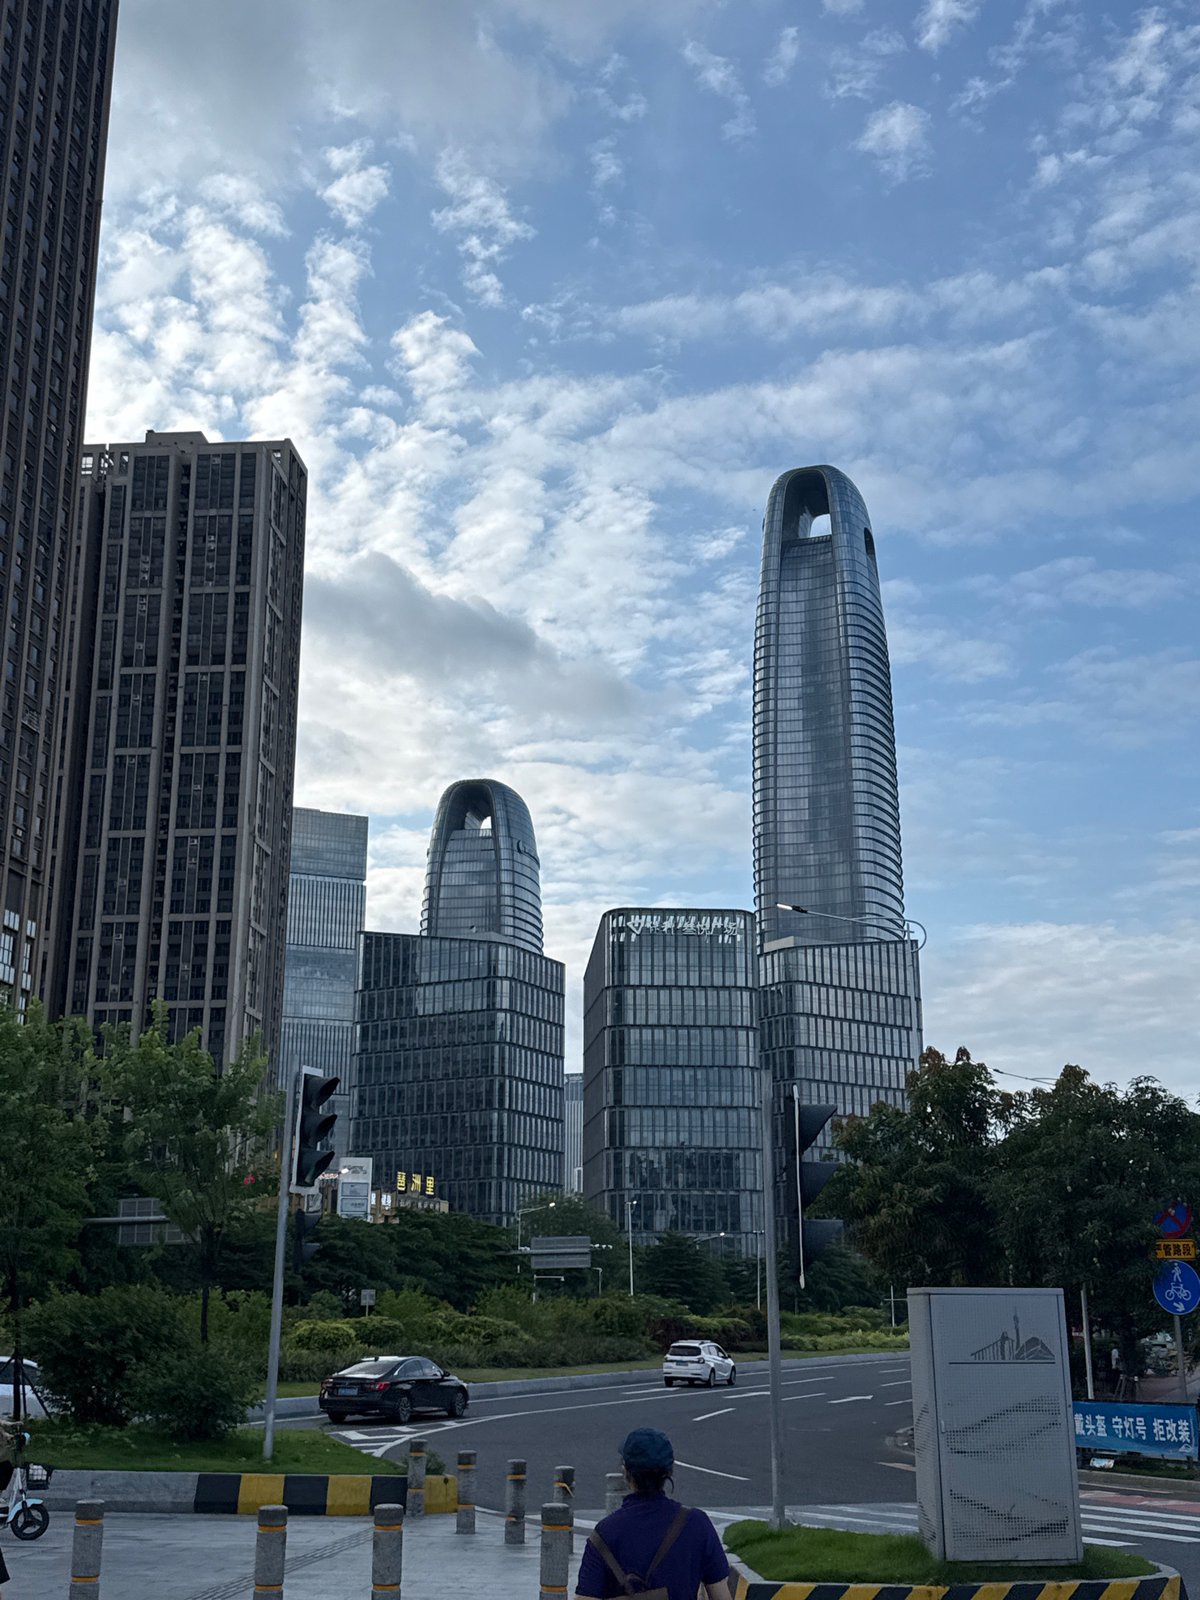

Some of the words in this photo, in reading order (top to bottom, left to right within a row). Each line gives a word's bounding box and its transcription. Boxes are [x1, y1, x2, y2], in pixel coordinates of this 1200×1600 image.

[396, 1171, 435, 1195] 琶洲里
[1074, 1412, 1107, 1437] 戴头盔
[1111, 1415, 1146, 1441] 守灯号
[1152, 1417, 1191, 1443] 拒改装
